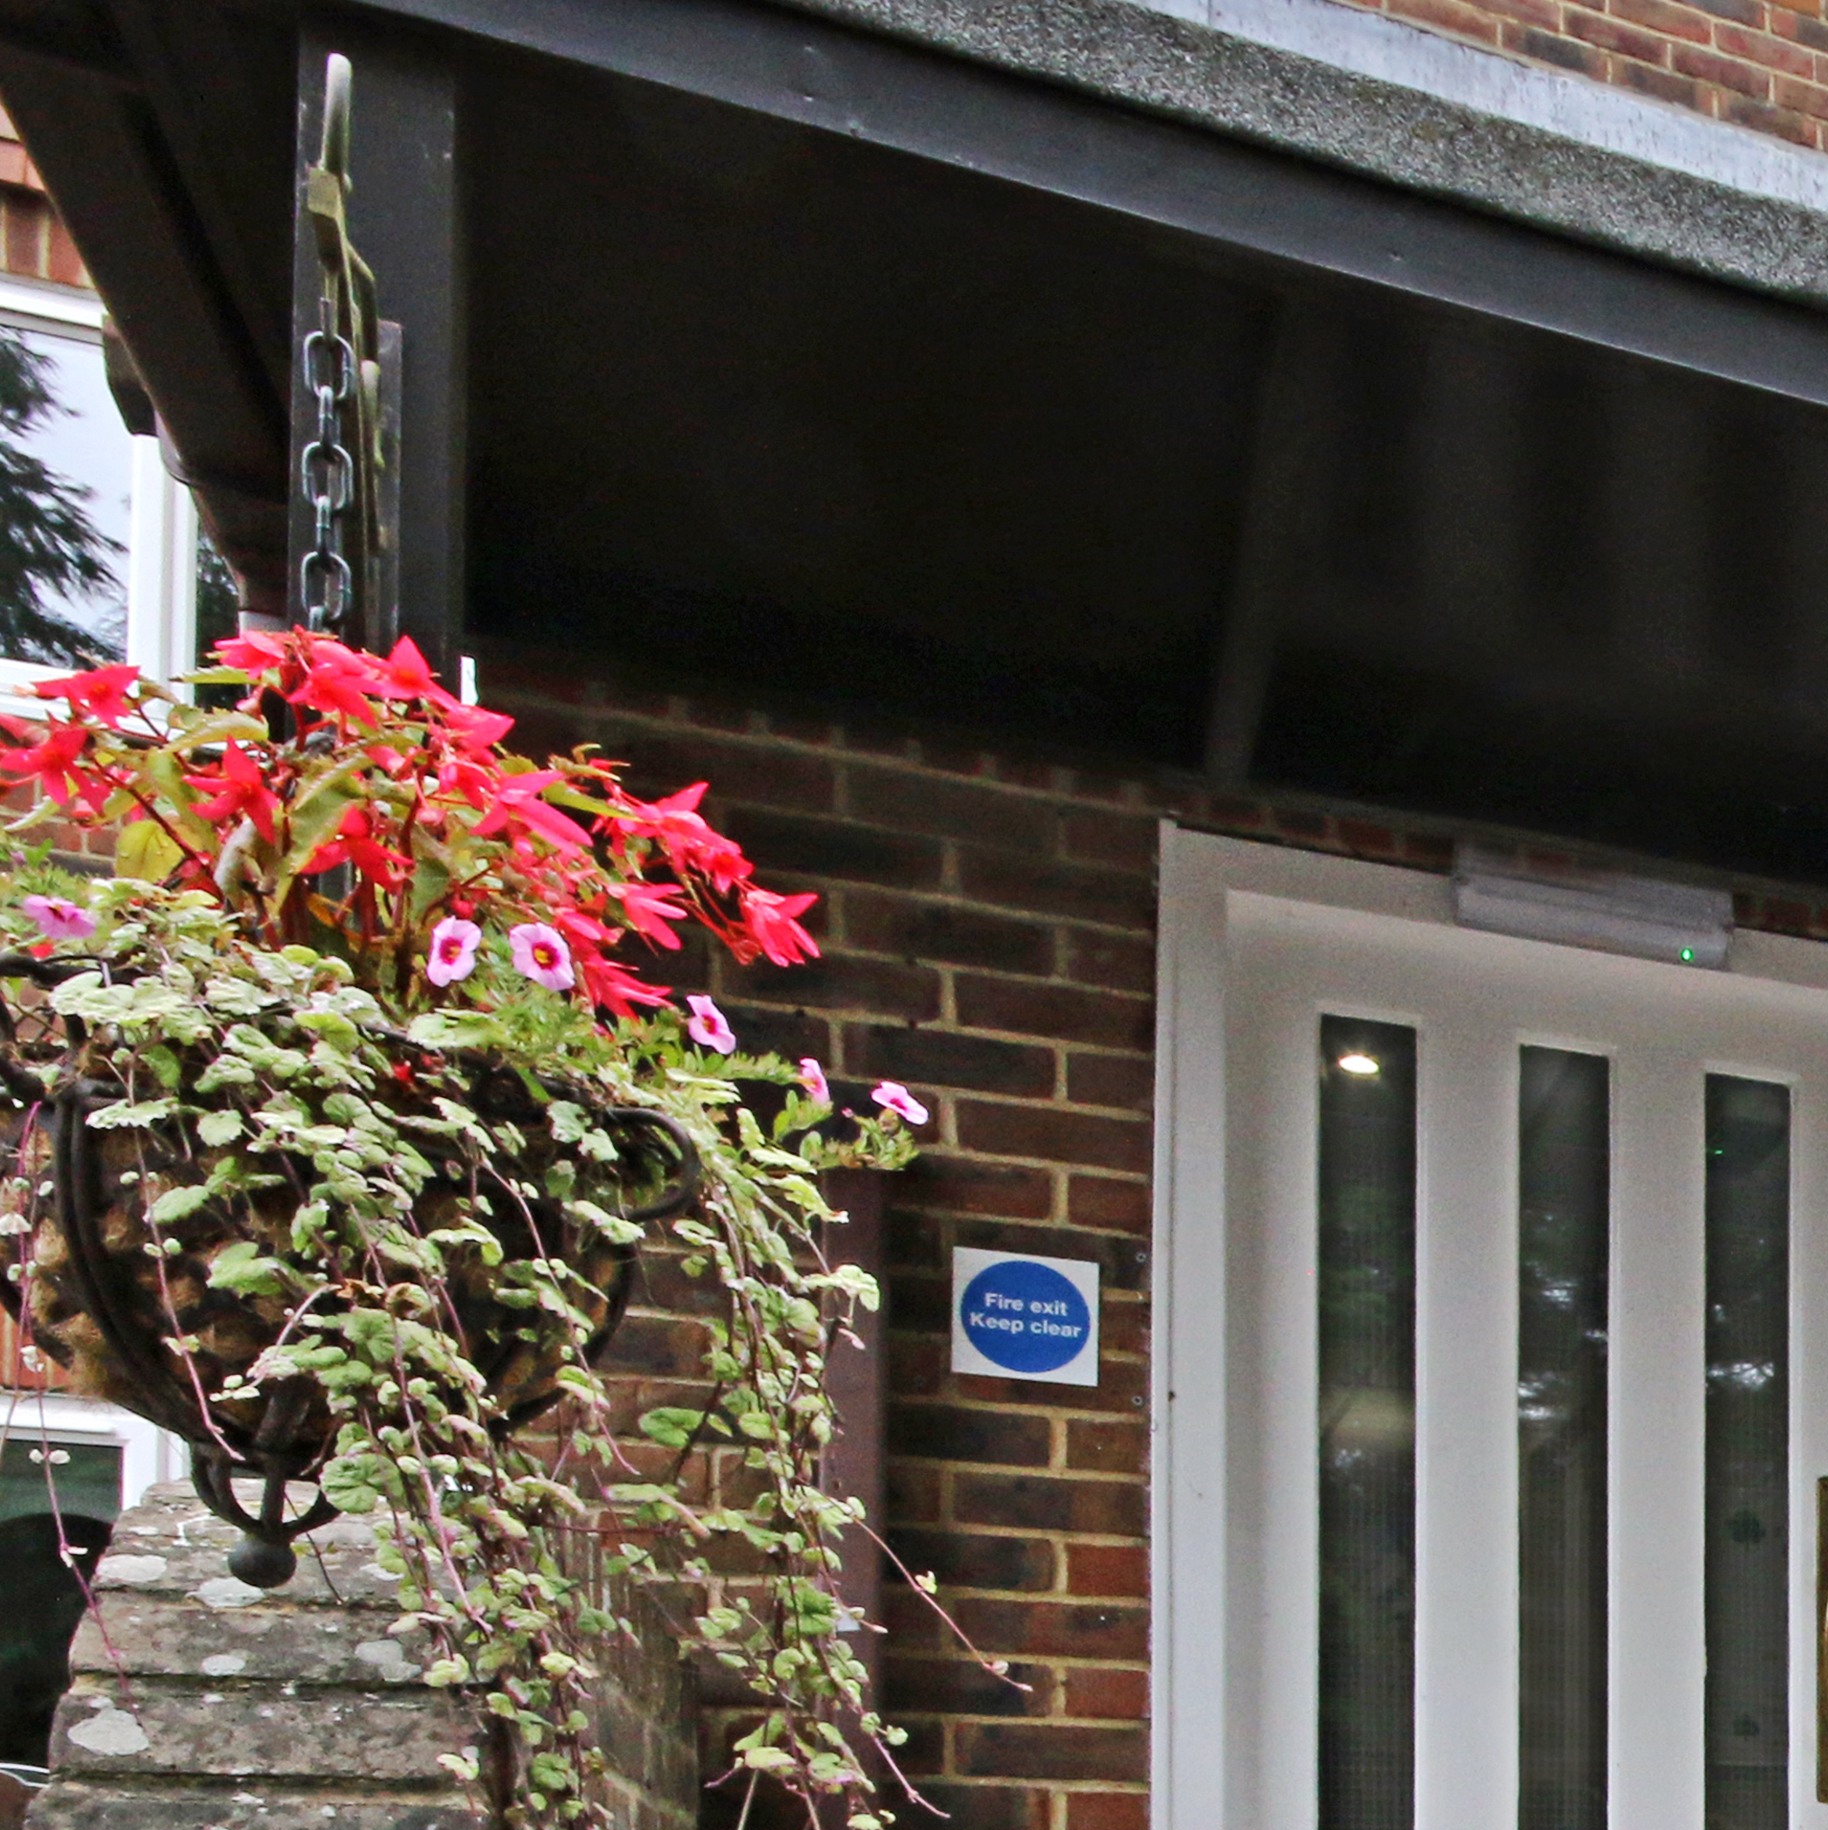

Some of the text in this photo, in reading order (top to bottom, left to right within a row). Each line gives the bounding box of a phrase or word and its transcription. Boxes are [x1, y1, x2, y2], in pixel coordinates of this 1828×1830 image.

[984, 1292, 1068, 1316] Fire exit
[969, 1312, 1082, 1338] Keep clear
